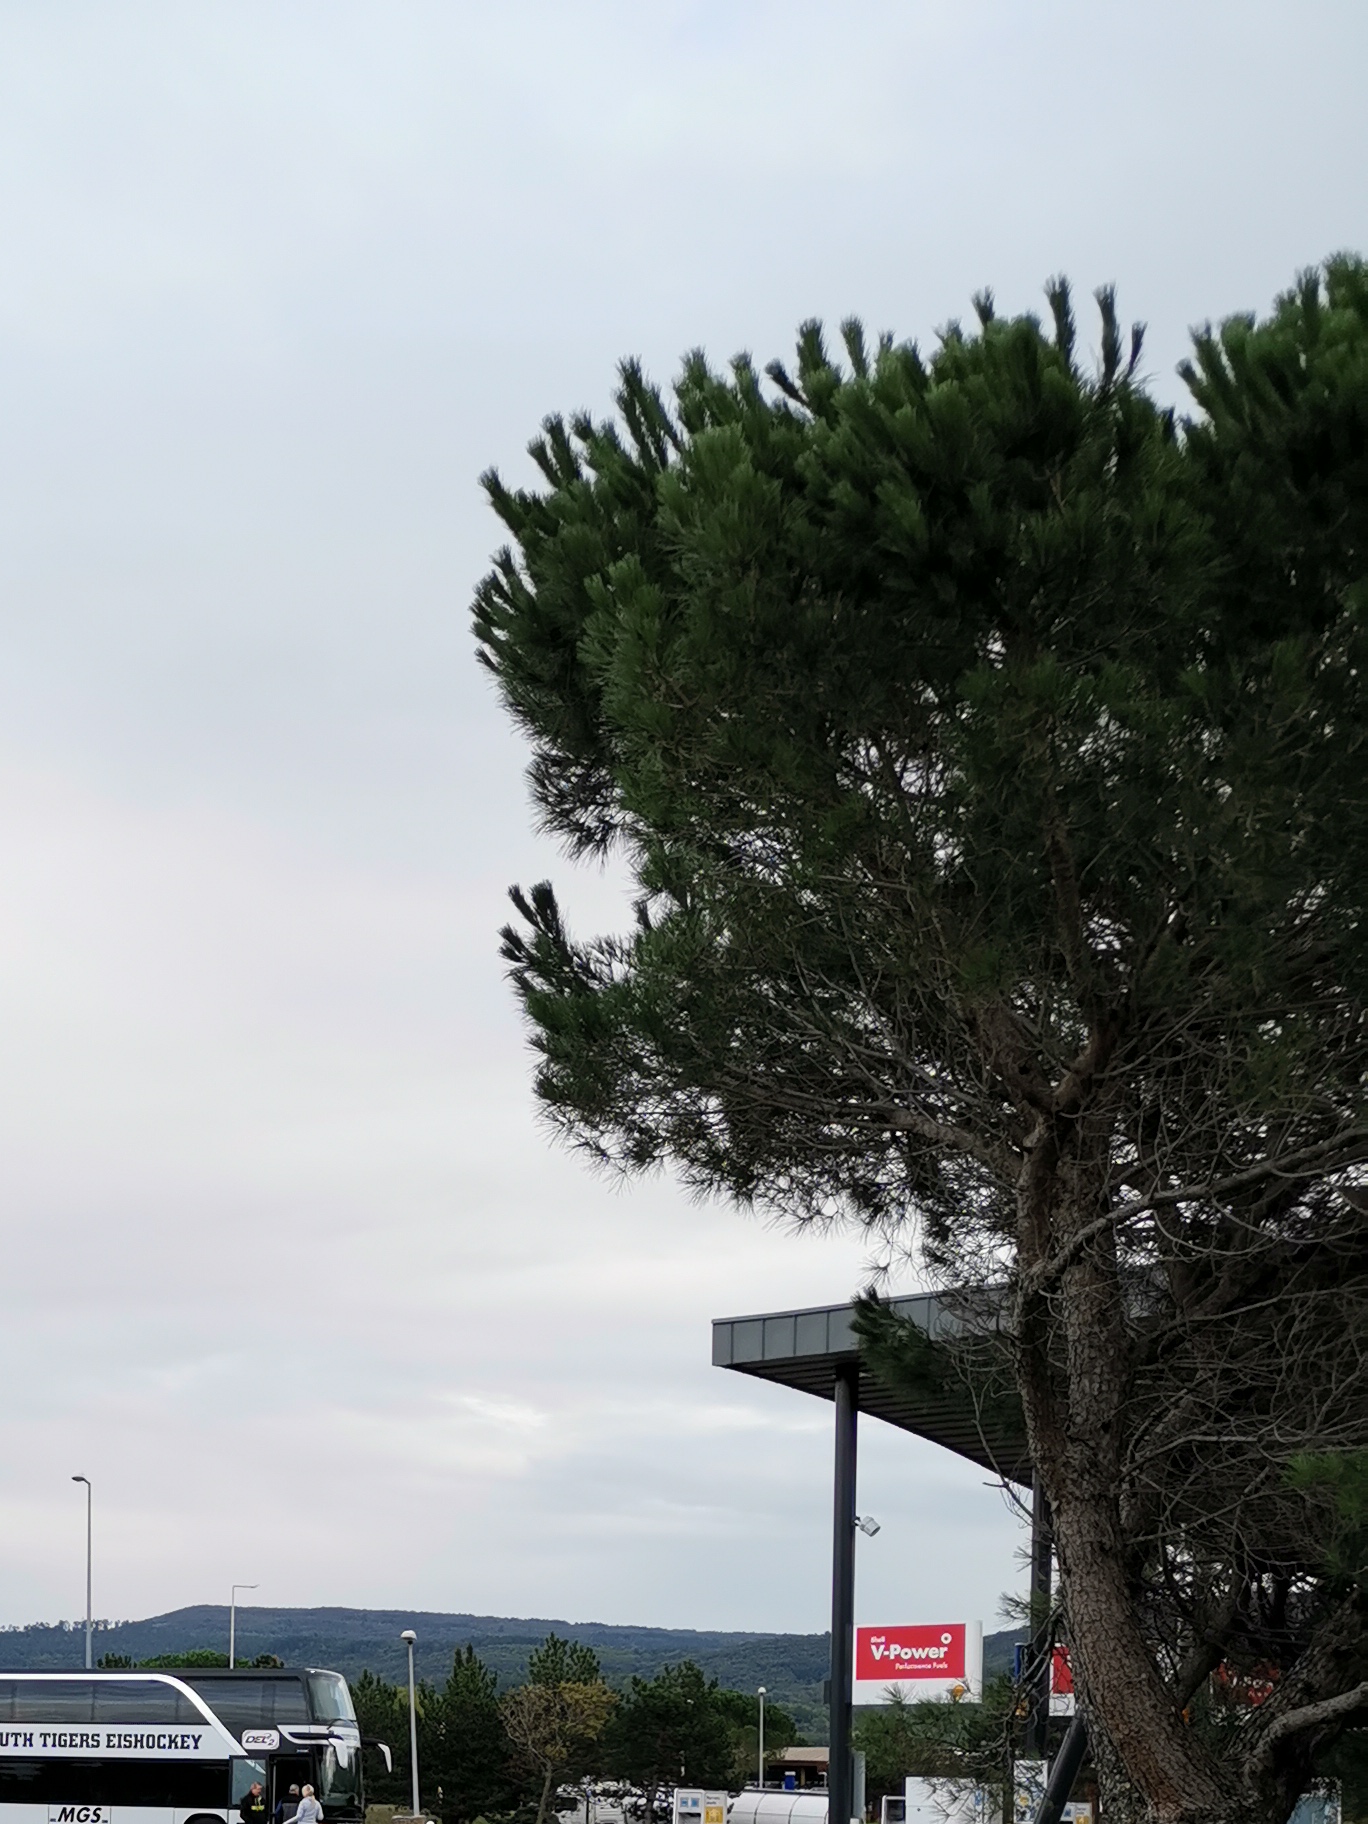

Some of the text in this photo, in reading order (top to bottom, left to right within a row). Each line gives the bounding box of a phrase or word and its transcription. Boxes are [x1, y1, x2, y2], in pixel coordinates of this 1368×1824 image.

[870, 1644, 948, 1660] V-Power
[39, 1732, 101, 1748] TIGERS
[105, 1733, 202, 1750] EISHOCKEY
[57, 1806, 102, 1823] MGS
